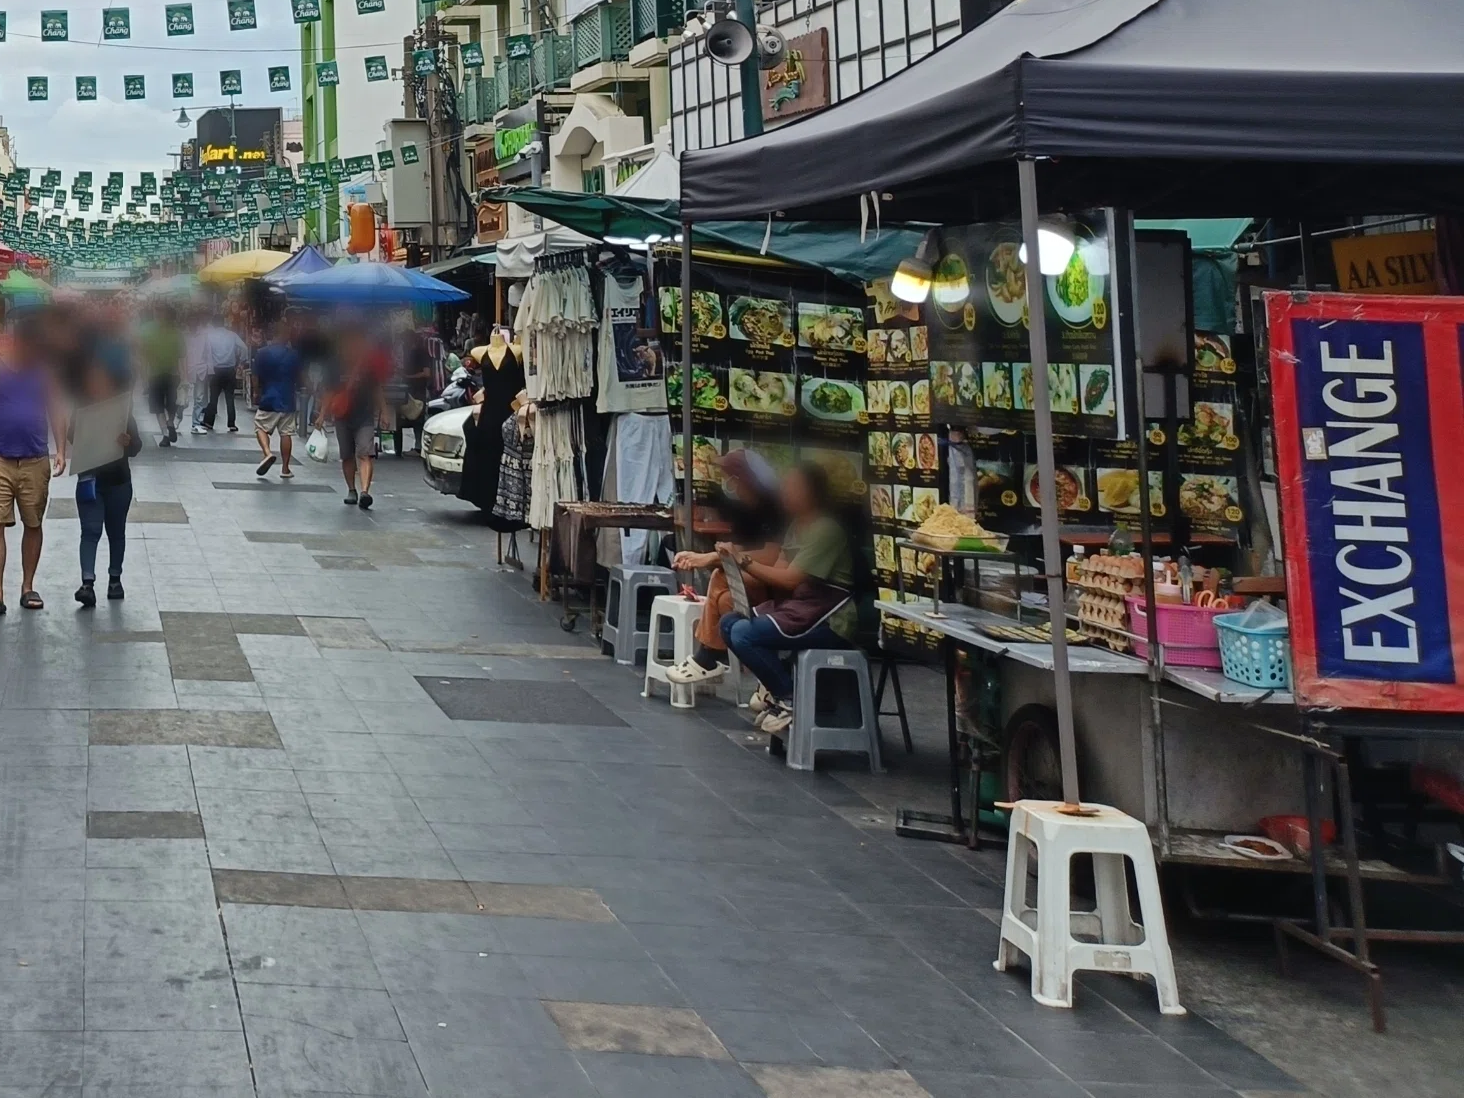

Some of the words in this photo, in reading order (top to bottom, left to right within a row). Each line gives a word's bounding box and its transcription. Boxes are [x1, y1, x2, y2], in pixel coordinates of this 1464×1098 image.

[295, 10, 318, 18] Chang
[231, 17, 254, 25] Chang
[43, 29, 66, 37] Chang
[1347, 259, 1383, 290] AA
[1092, 303, 1105, 314] 120
[1320, 340, 1420, 664] EXCHANGE
